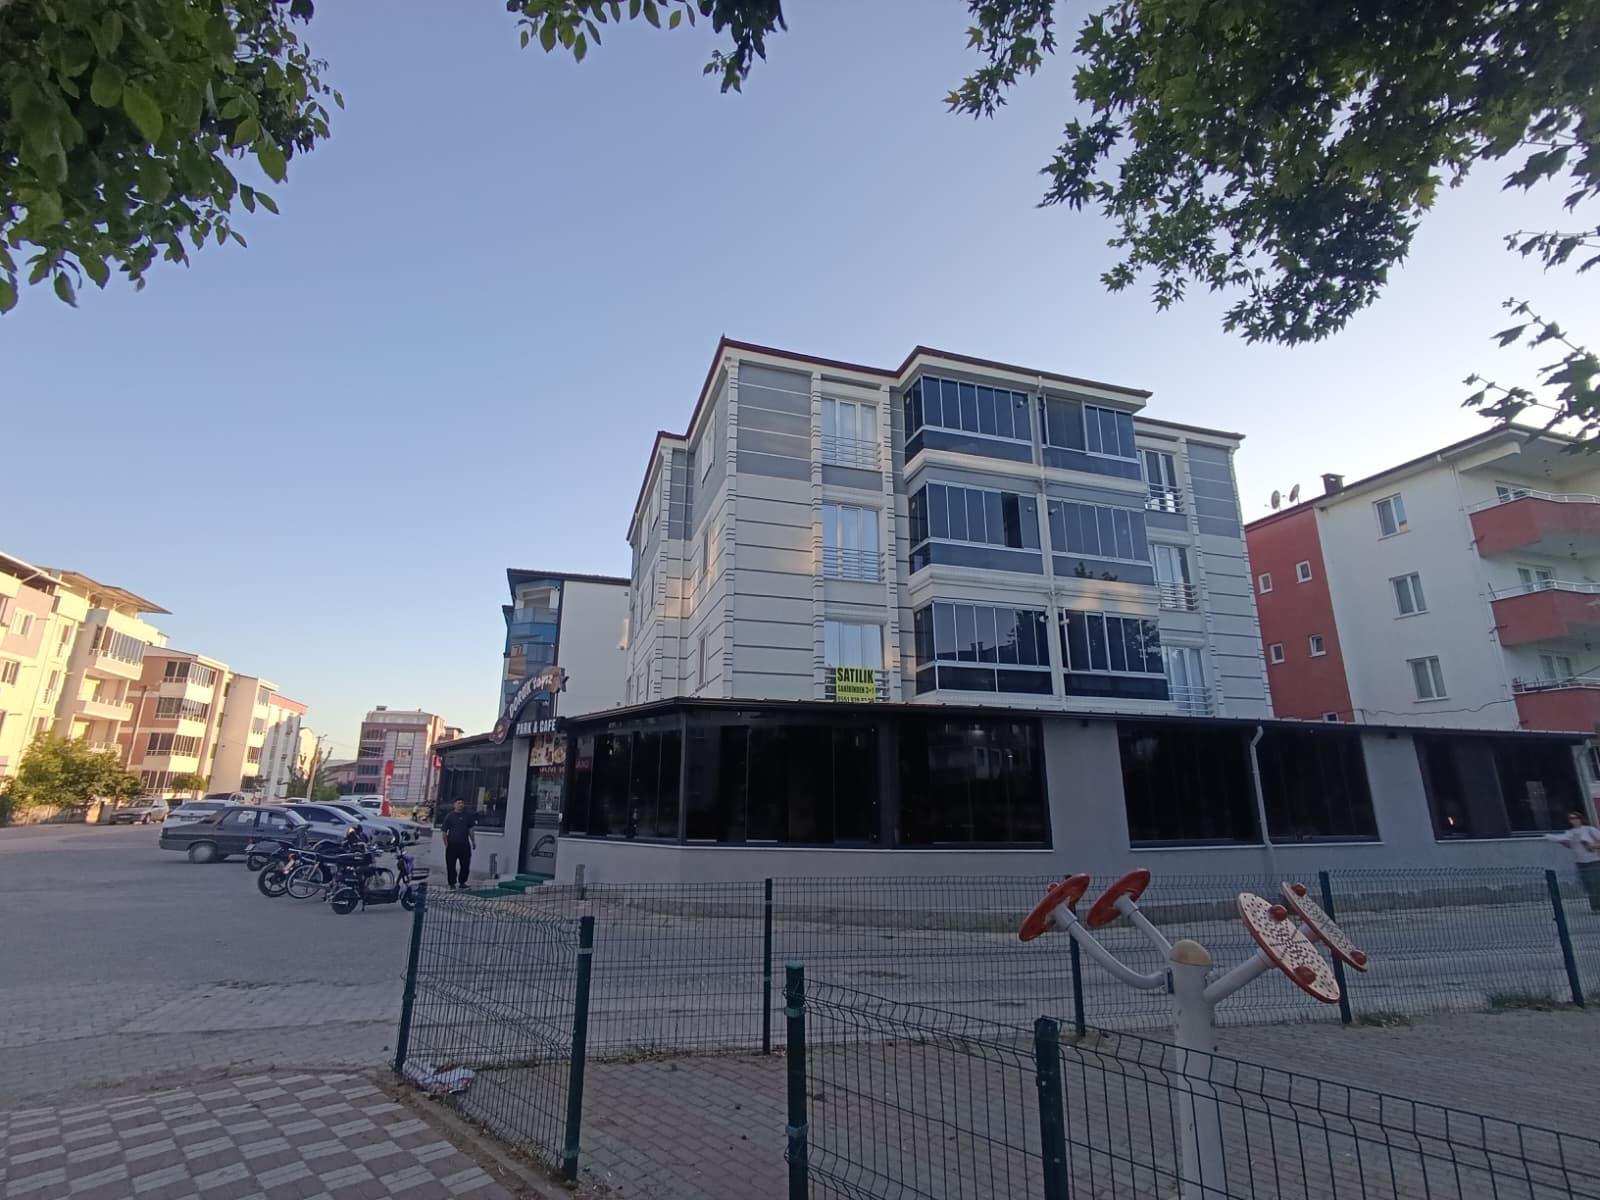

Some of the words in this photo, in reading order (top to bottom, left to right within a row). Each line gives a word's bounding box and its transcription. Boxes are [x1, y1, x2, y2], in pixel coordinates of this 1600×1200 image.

[837, 667, 874, 684] SATILIK
[516, 722, 533, 736] PARK
[540, 719, 557, 733] CAFE
